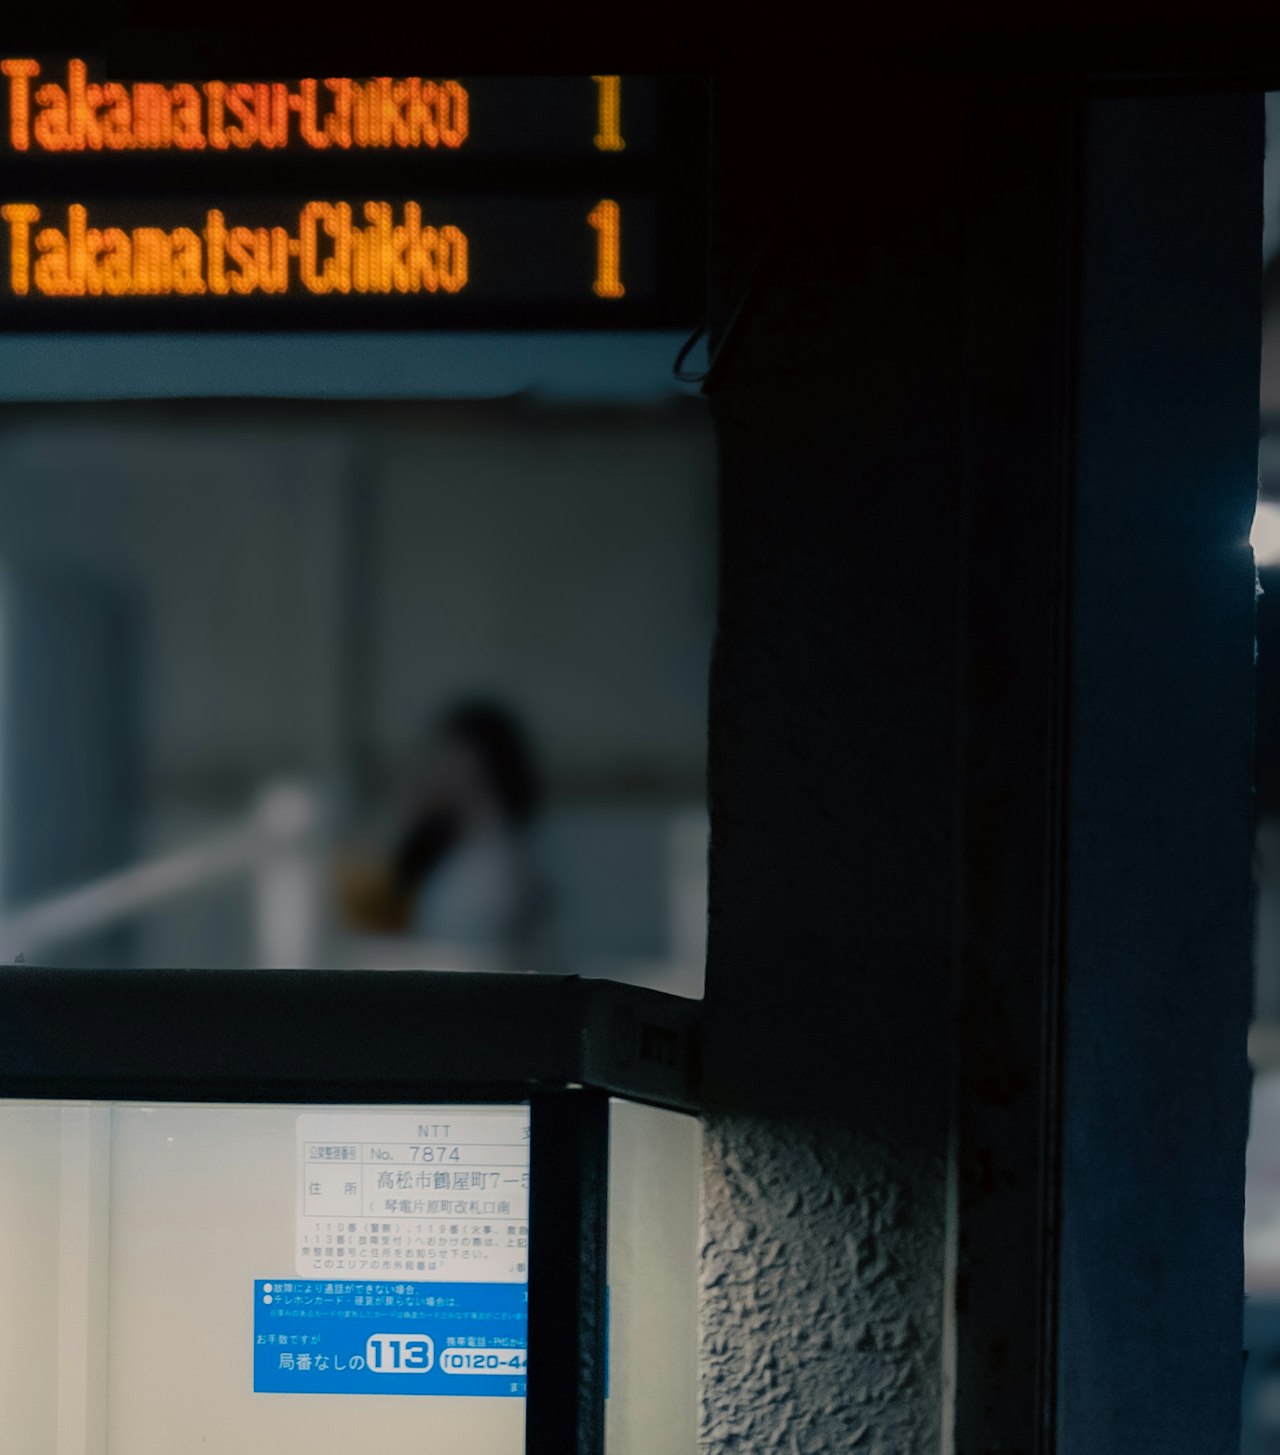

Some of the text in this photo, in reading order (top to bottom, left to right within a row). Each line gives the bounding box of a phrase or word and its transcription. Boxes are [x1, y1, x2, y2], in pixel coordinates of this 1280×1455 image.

[1, 58, 469, 151] Takamatsu-Chikko
[591, 75, 625, 151] 1
[1, 200, 469, 296] Takamatsu-Chikko
[587, 199, 625, 298] 1
[418, 1125, 450, 1138] NTT
[371, 1148, 394, 1161] No.
[409, 1146, 460, 1163] 7874
[309, 1182, 358, 1196] 住所
[278, 1352, 364, 1372] 局番なしの
[369, 1340, 430, 1370] 113
